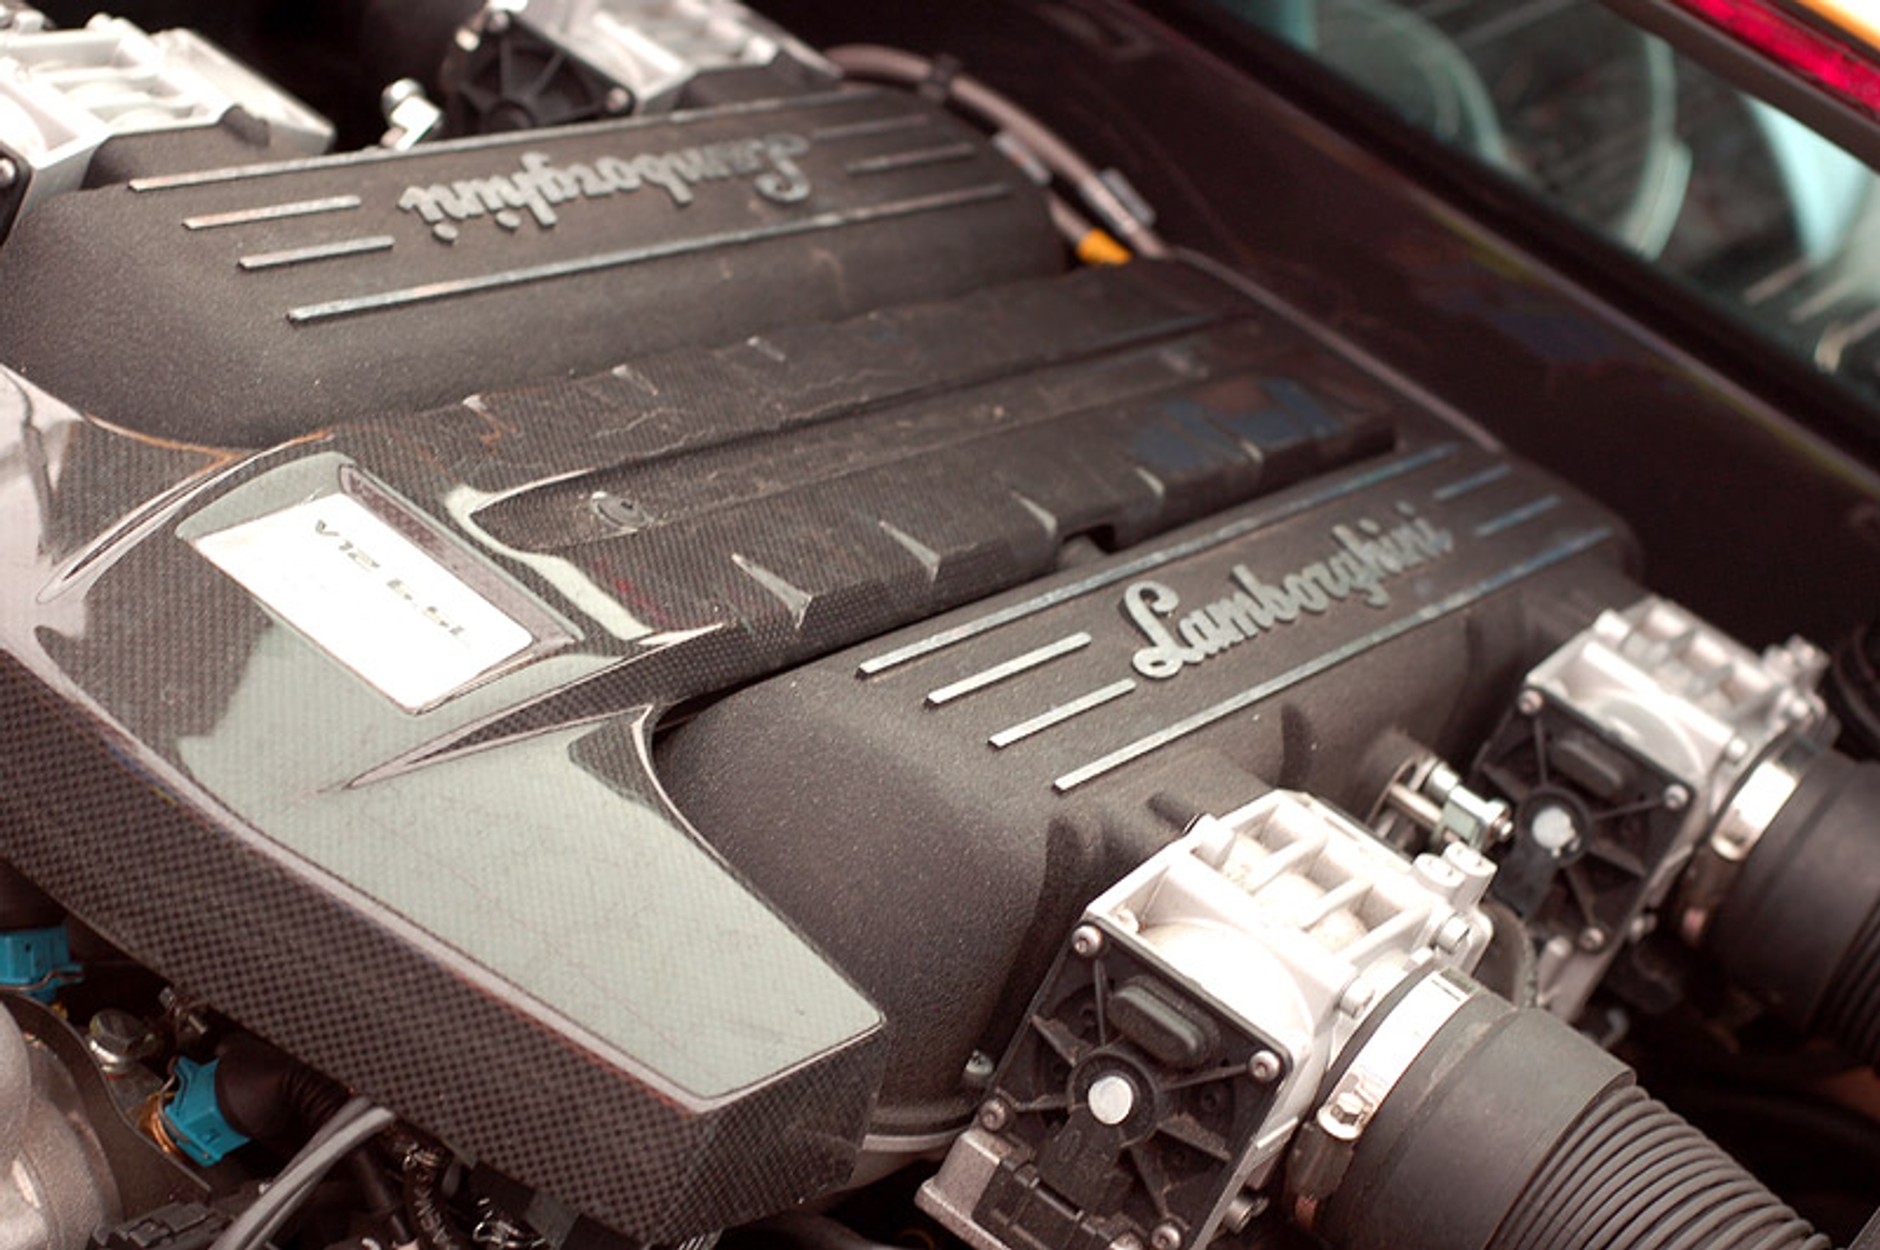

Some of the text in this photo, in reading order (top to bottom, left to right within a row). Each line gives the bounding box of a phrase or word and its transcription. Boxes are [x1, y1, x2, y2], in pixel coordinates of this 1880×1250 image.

[398, 134, 810, 243] Lamborghini
[315, 518, 381, 571] V12
[1124, 502, 1454, 678] Lamborghini
